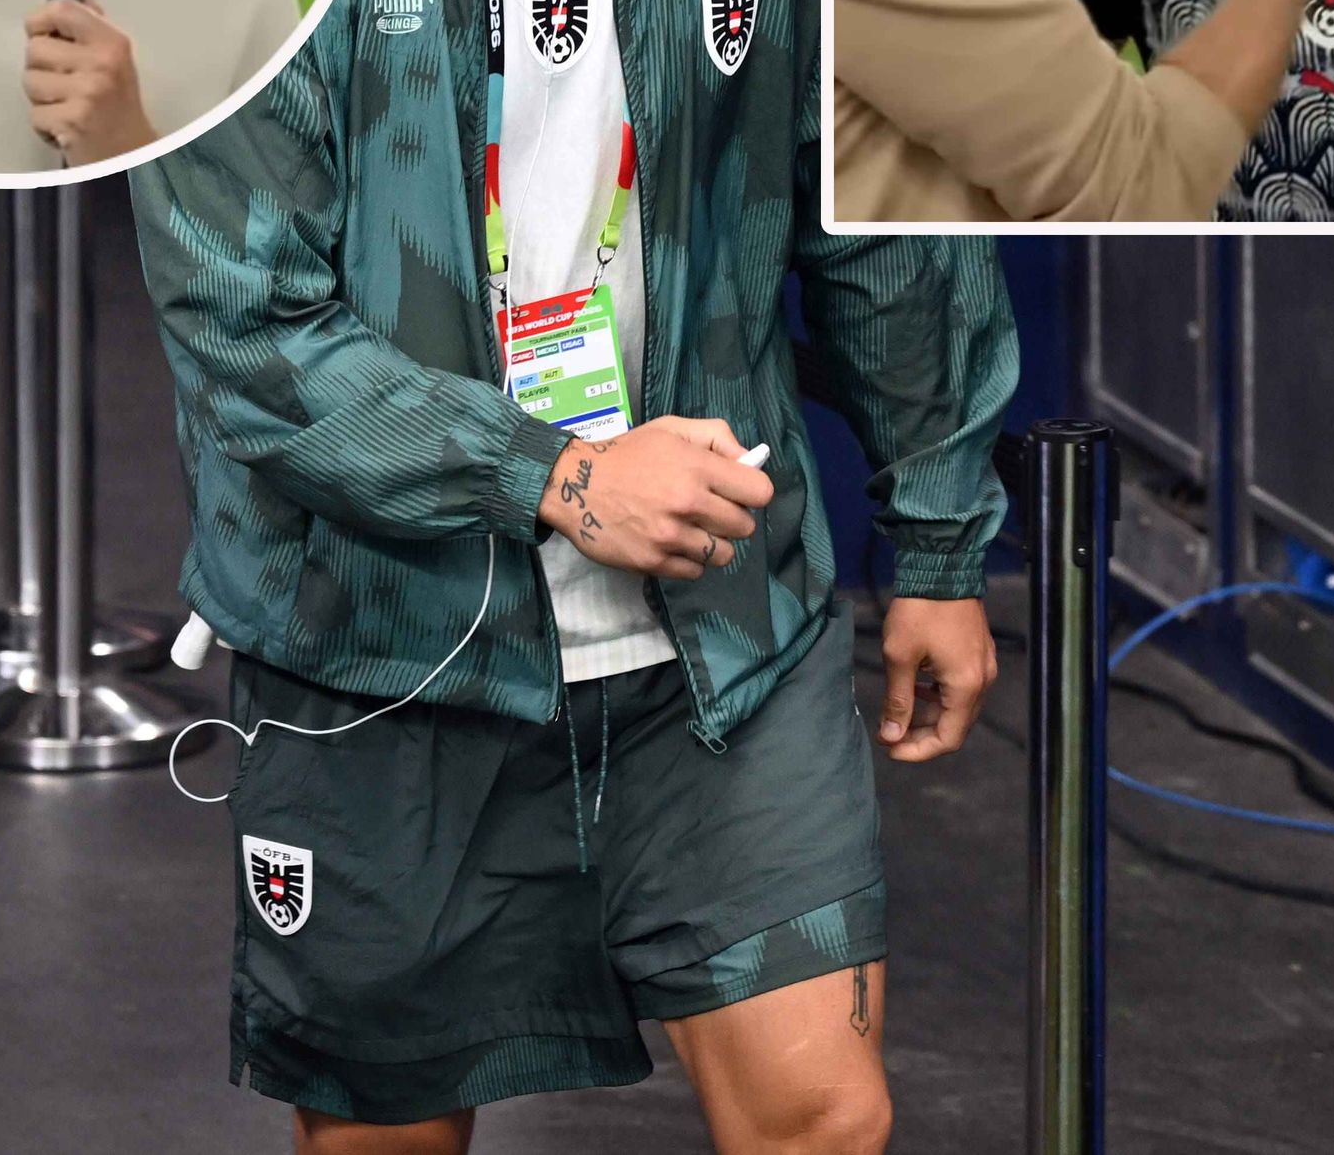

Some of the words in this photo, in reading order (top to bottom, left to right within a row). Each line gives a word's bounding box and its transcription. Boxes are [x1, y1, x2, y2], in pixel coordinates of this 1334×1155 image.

[384, 17, 411, 30] KING
[524, 316, 555, 330] WORLD
[555, 312, 573, 323] CUP
[518, 386, 550, 399] PLAYER
[263, 848, 291, 861] ÖFB
